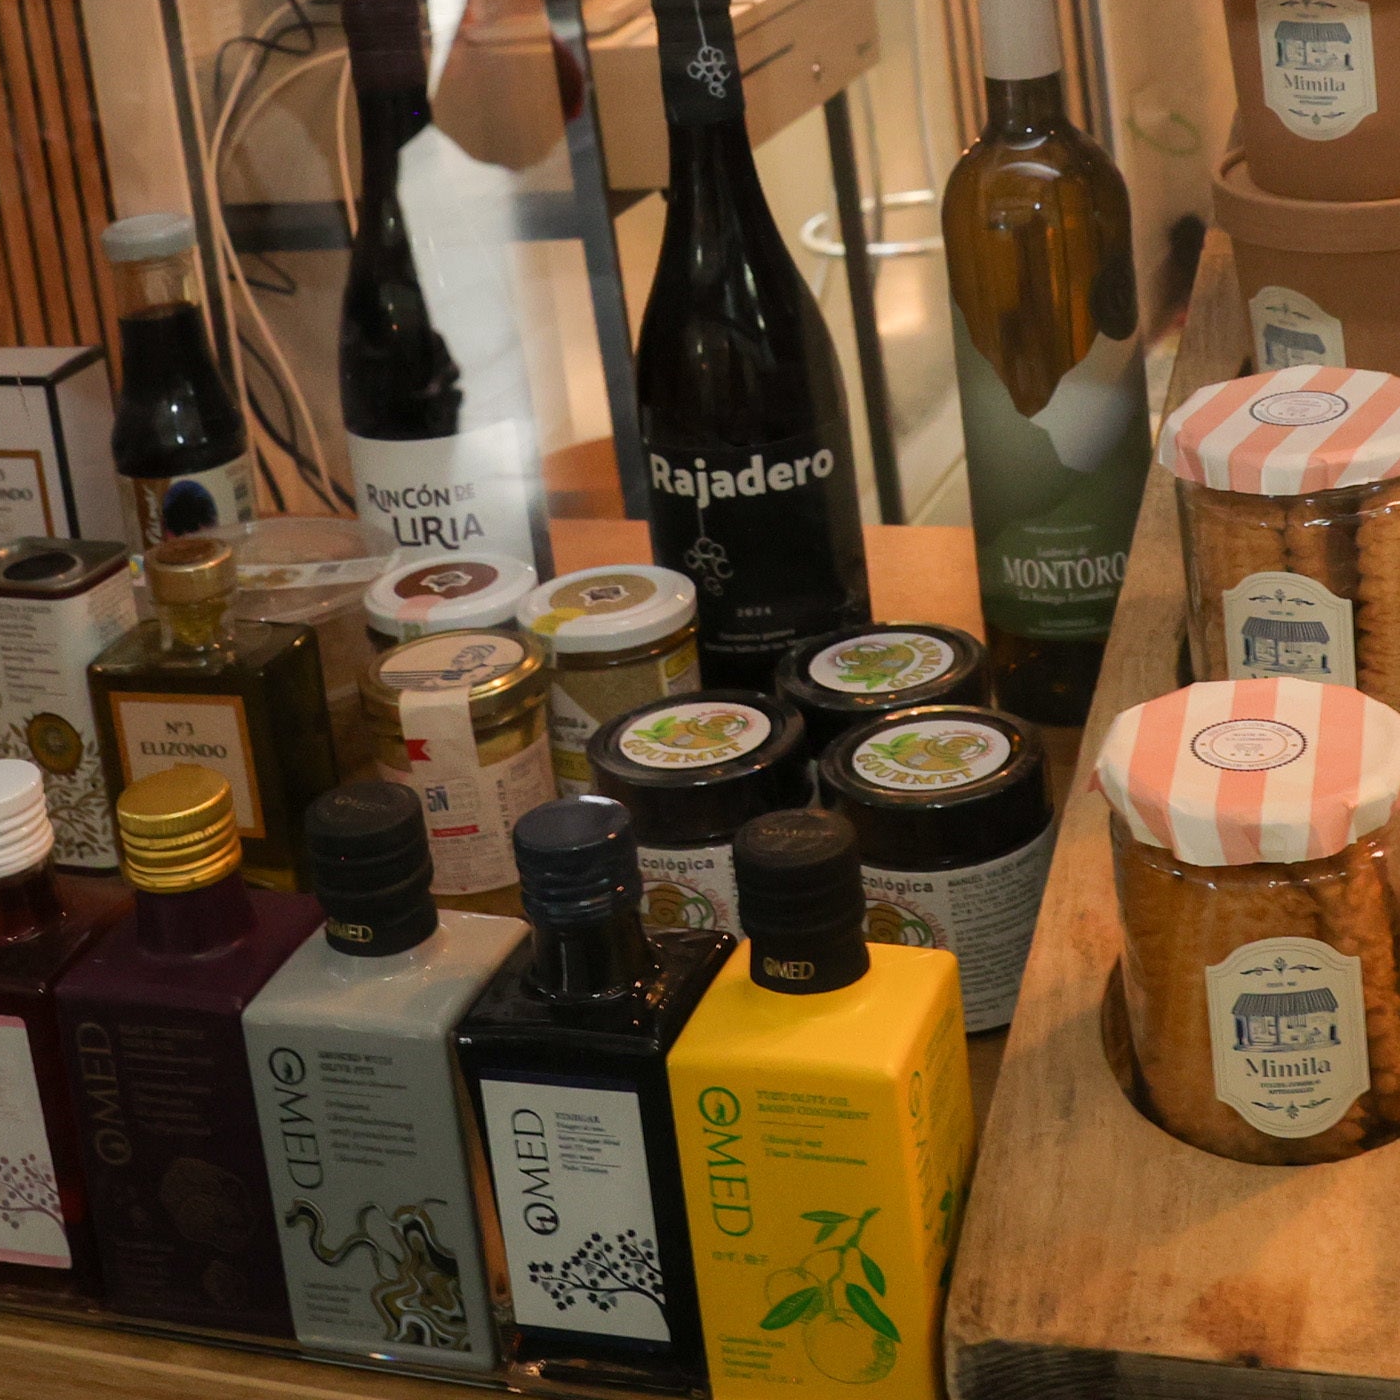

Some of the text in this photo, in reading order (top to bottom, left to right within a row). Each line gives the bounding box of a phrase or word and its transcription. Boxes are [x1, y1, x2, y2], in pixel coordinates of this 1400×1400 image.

[1284, 73, 1346, 95] Mimila
[650, 448, 835, 509] Rajadero
[366, 482, 451, 512] RINCÓN
[1002, 551, 1128, 589] MONTORO
[140, 739, 228, 759] ELIZONDO
[623, 739, 742, 763] GOURMET
[856, 752, 972, 784] GOURMET
[1246, 1055, 1331, 1081] Mimila
